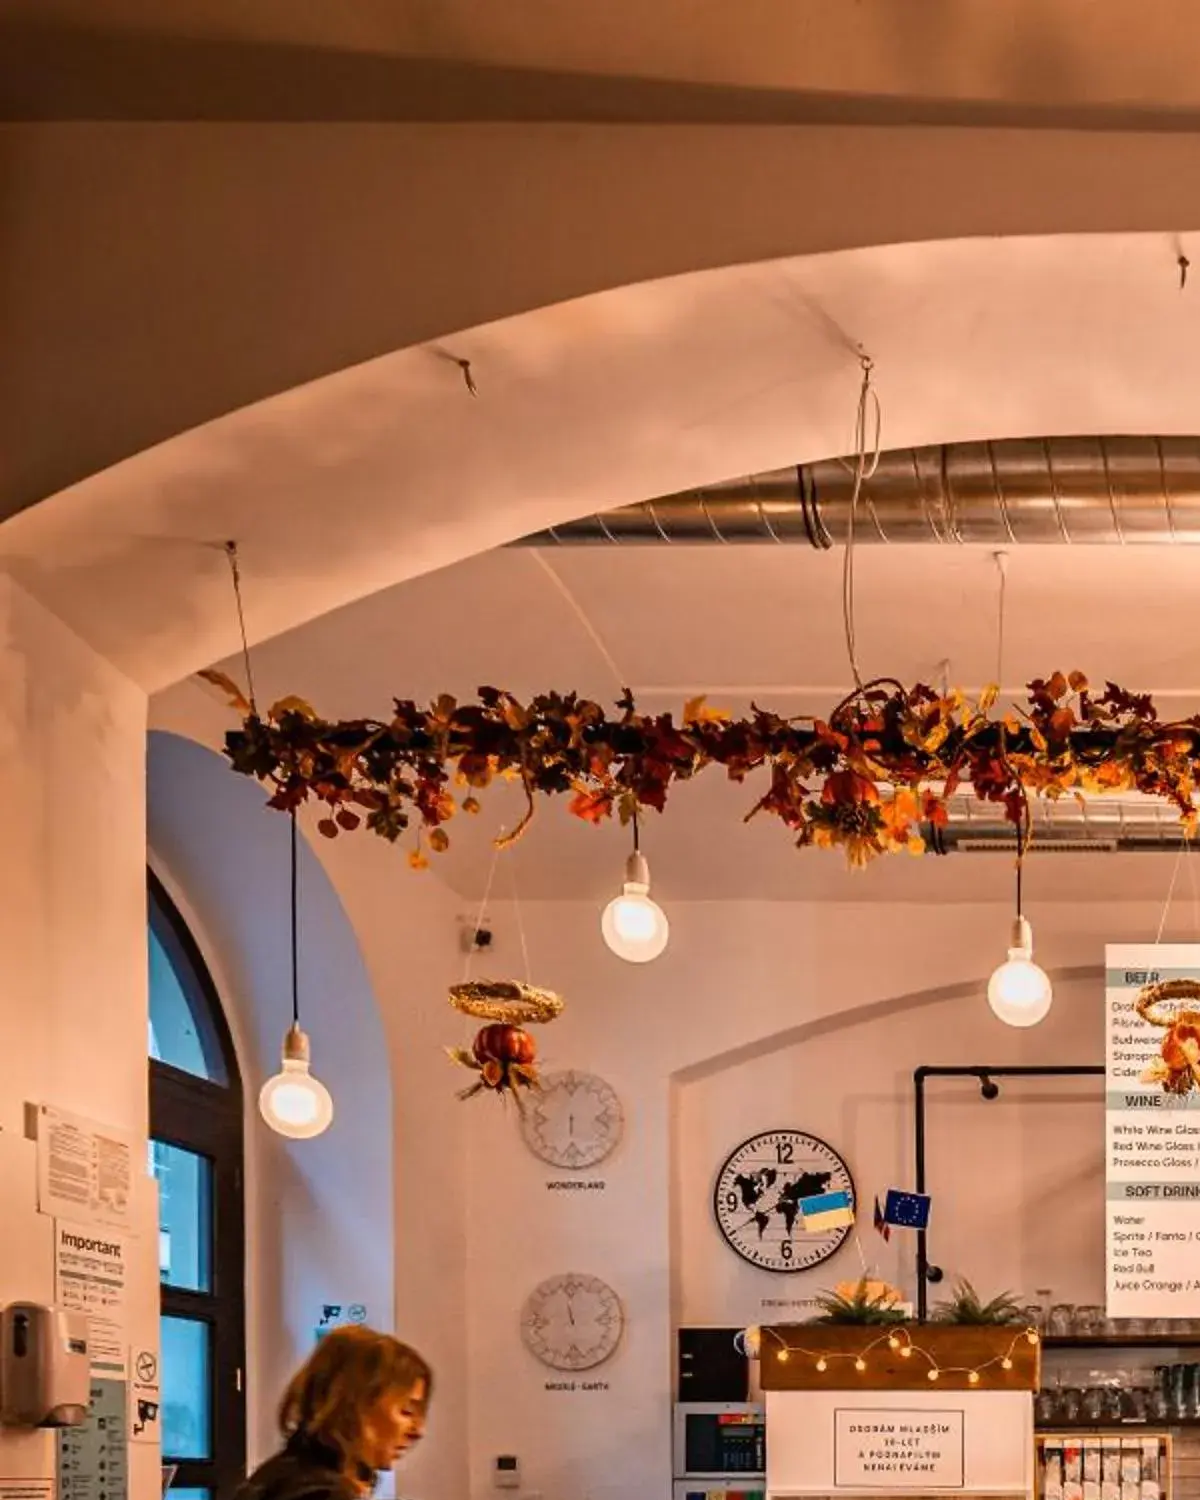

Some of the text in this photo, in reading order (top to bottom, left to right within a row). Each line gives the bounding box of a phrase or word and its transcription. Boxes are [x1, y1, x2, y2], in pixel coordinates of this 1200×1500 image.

[1112, 1067, 1142, 1078] Cider
[1124, 1096, 1161, 1108] WINE
[1112, 1124, 1143, 1136] White
[1146, 1124, 1174, 1136] Wine
[1112, 1140, 1133, 1152] Red
[1136, 1140, 1163, 1152] Wine
[1165, 1140, 1195, 1152] Glass
[776, 1143, 793, 1164] 12
[1112, 1157, 1160, 1168] Prosecco
[1163, 1157, 1192, 1168] Glass
[546, 1181, 605, 1190] WONDERLAND
[1124, 1185, 1160, 1197] SOFT
[725, 1194, 738, 1211] 9
[1112, 1215, 1145, 1226] Water
[61, 1229, 121, 1257] Important
[1112, 1231, 1146, 1243] Sprite
[1155, 1231, 1187, 1242] Fanta
[780, 1239, 792, 1259] 6
[1112, 1247, 1153, 1258] Ice Tea
[1112, 1263, 1134, 1274] Red
[1113, 1279, 1140, 1290] Juice
[1142, 1279, 1183, 1292] Orange
[857, 1450, 865, 1459] A
